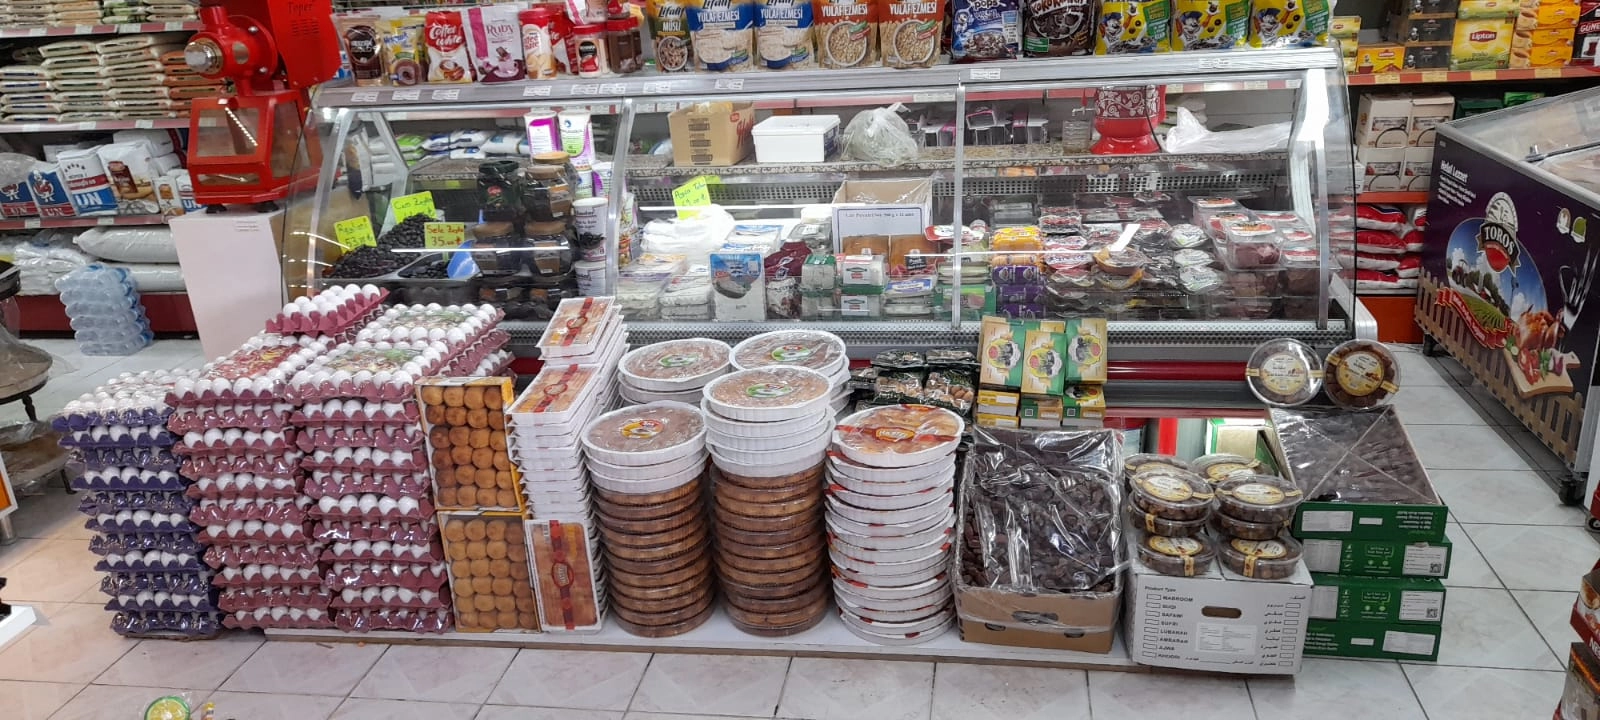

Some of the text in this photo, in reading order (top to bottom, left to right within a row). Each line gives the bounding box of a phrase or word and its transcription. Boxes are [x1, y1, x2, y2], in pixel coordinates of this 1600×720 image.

[760, 9, 780, 20] YULAF
[821, 3, 868, 17] YULAF EZMESİ
[889, 1, 937, 15] YULAF EZMESİ
[697, 10, 717, 23] YULAF
[429, 22, 457, 40] Coffee
[1470, 32, 1496, 41] Lipton
[436, 34, 463, 46] white
[74, 192, 103, 206] UN
[11, 206, 28, 215] UN
[46, 207, 65, 216] UN
[1483, 225, 1515, 256] TOROS
